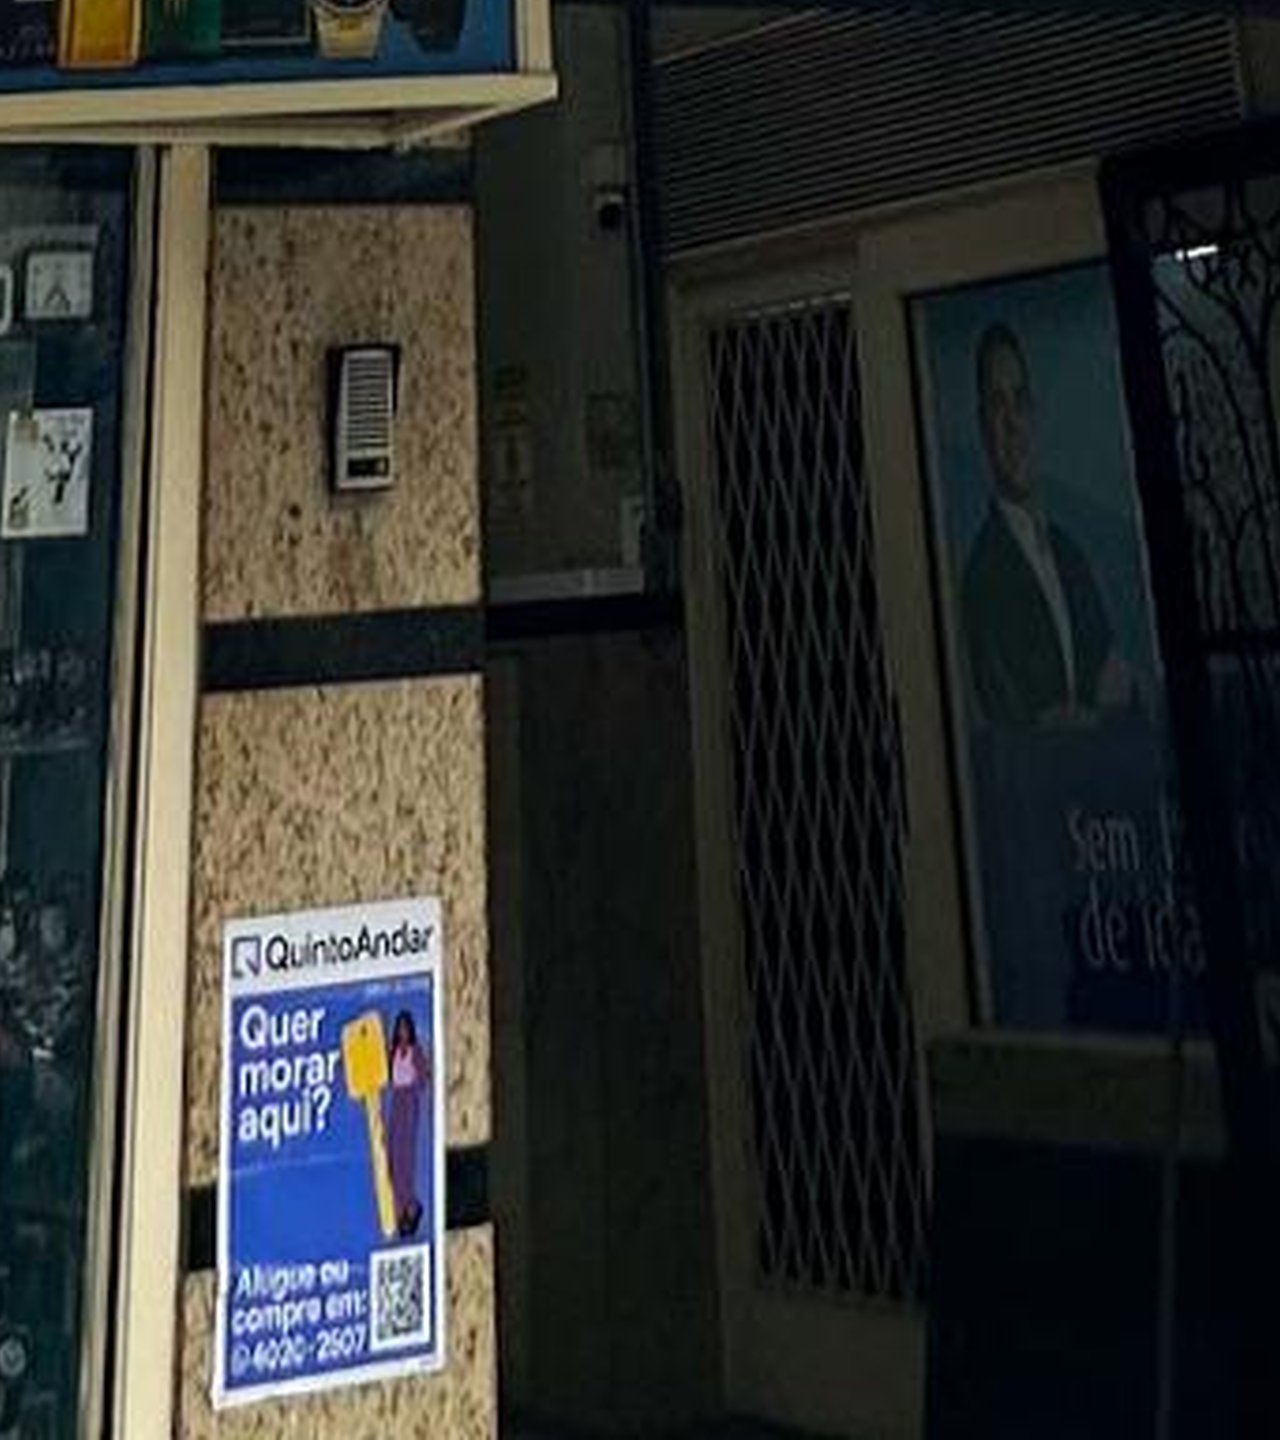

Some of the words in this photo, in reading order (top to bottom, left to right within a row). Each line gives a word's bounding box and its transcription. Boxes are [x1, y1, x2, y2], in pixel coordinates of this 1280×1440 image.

[266, 920, 433, 972] QuintoAndar
[239, 1005, 326, 1049] Quer
[238, 1051, 341, 1098] morar
[237, 1085, 331, 1151] aqui?
